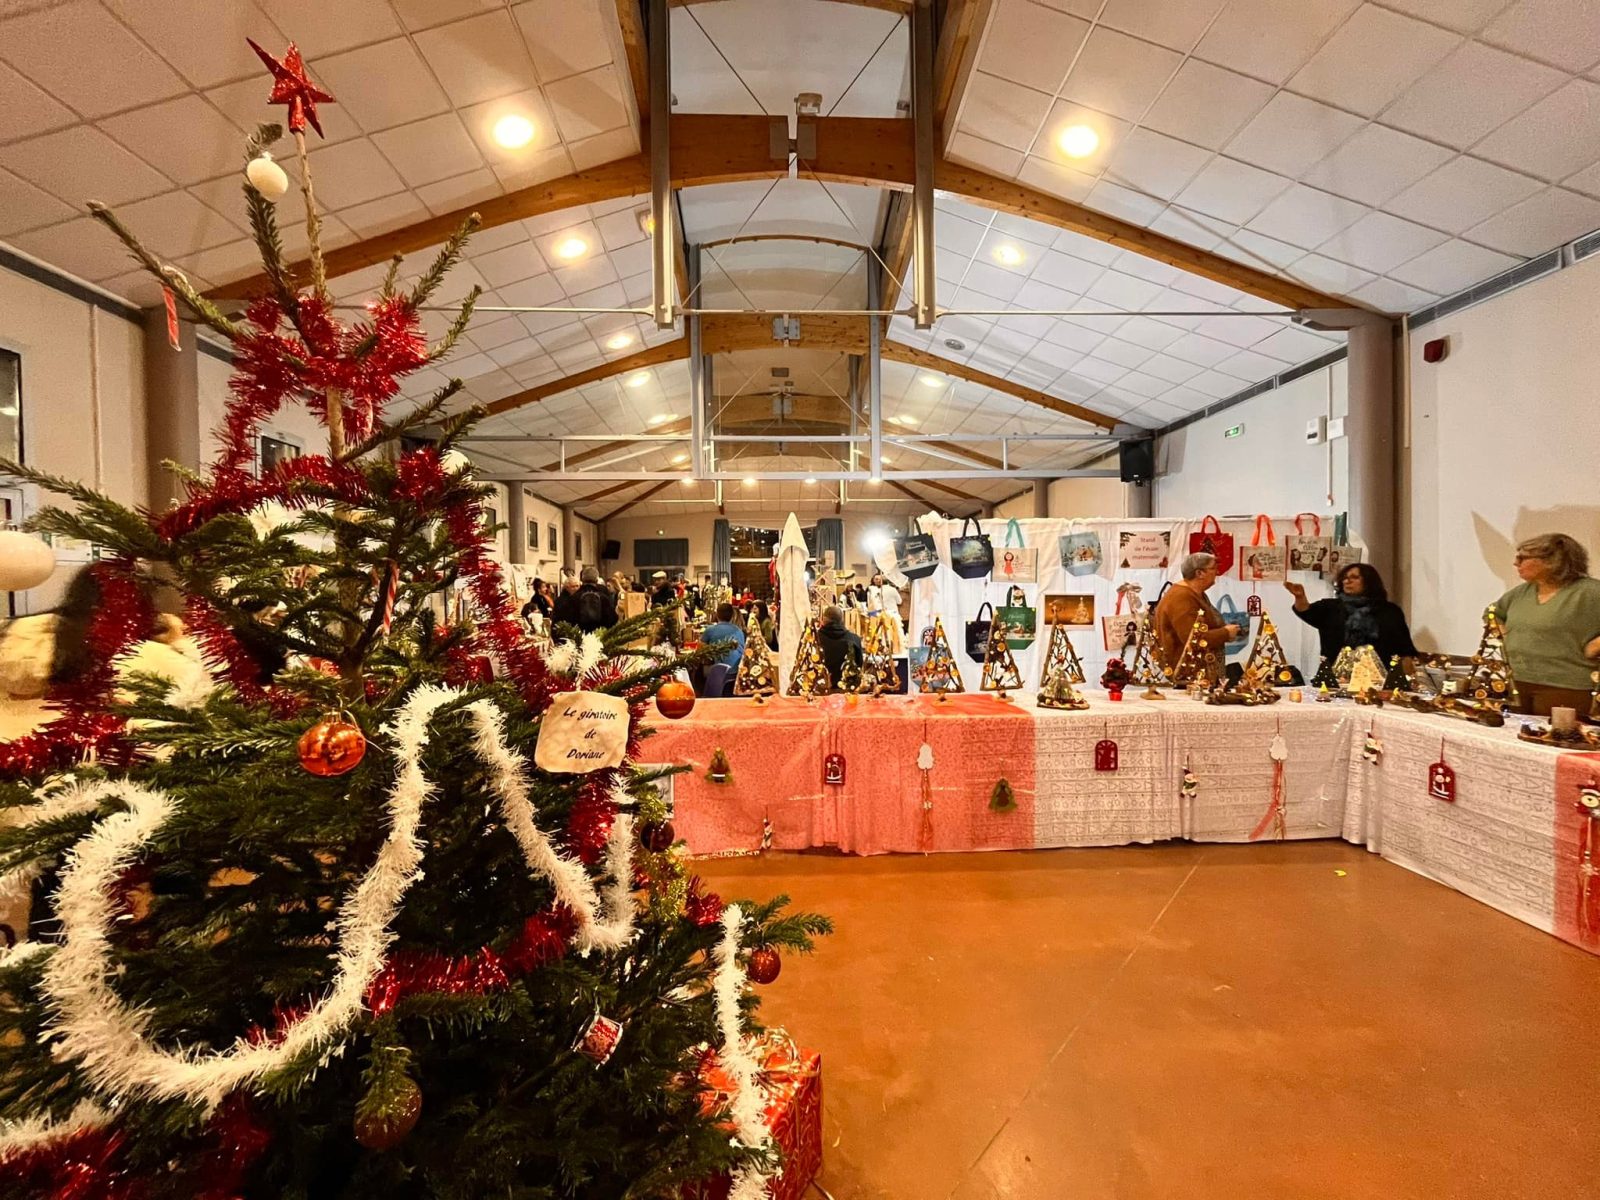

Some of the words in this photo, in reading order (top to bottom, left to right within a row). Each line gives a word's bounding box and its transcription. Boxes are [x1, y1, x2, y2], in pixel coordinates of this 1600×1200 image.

[563, 706, 577, 717] Le
[577, 708, 618, 721] giratoire
[584, 728, 597, 739] de
[566, 748, 605, 760] Doriane
